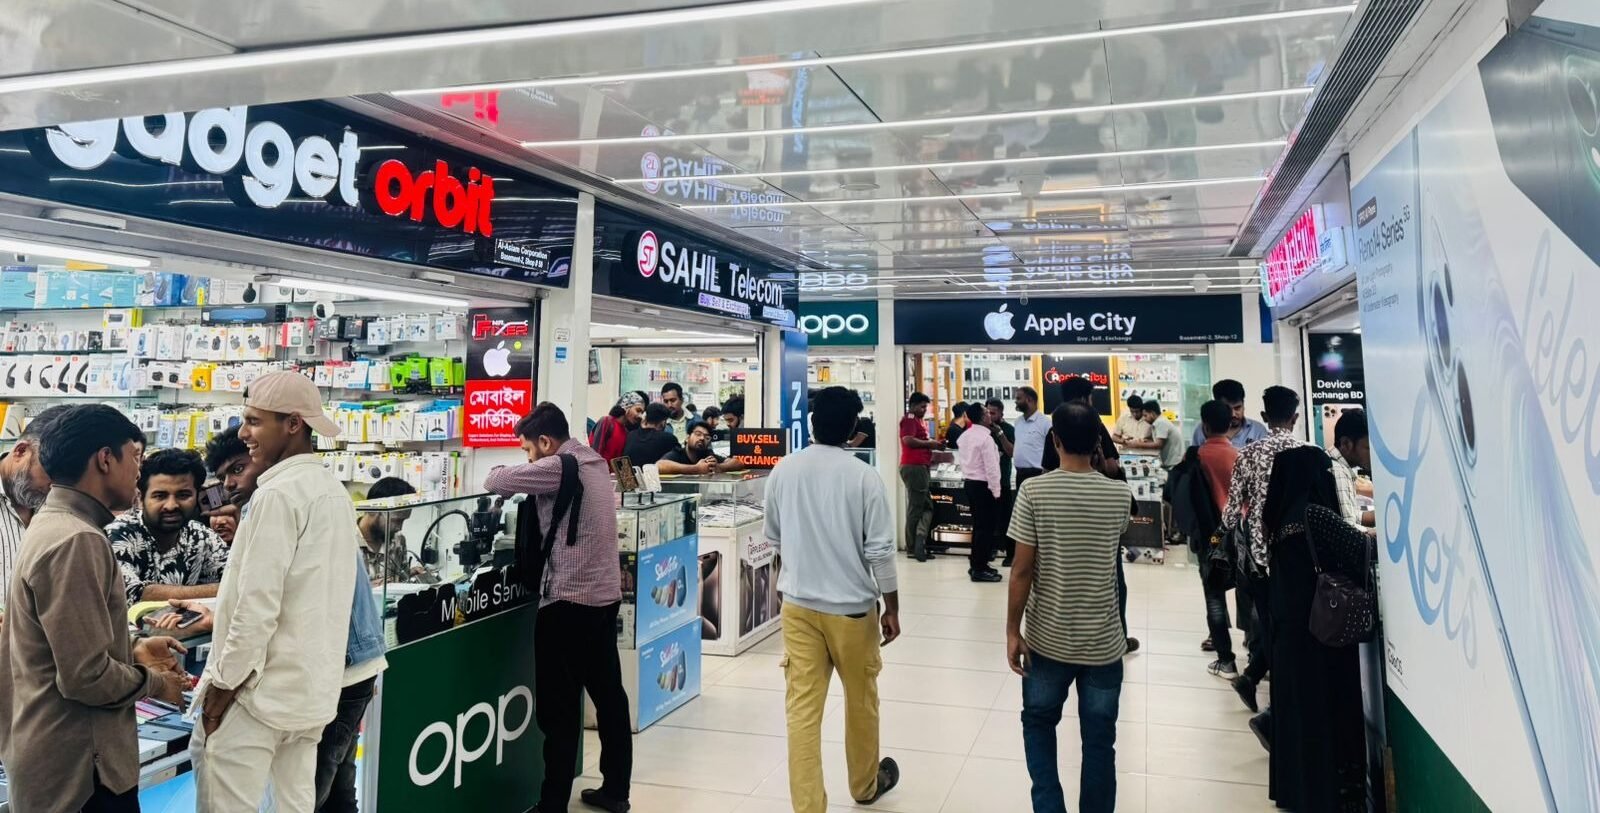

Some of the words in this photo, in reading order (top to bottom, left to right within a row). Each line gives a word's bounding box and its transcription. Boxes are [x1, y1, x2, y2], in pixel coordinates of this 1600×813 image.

[374, 159, 494, 238] orbit
[1359, 225, 1380, 263] Reno14
[1381, 214, 1405, 250] Series
[521, 246, 548, 260] Corporation
[659, 241, 721, 294] SAHIL
[729, 262, 782, 306] Telecom
[797, 313, 869, 339] ppo
[1024, 312, 1086, 336] Apple
[1090, 312, 1136, 336] City
[1317, 379, 1352, 389] Device
[469, 386, 527, 406] মোবাইল
[1312, 391, 1349, 400] xchange
[1350, 391, 1364, 399] BD
[736, 434, 780, 444] BUY.SELL
[753, 444, 762, 455] &
[408, 684, 534, 790] opp
